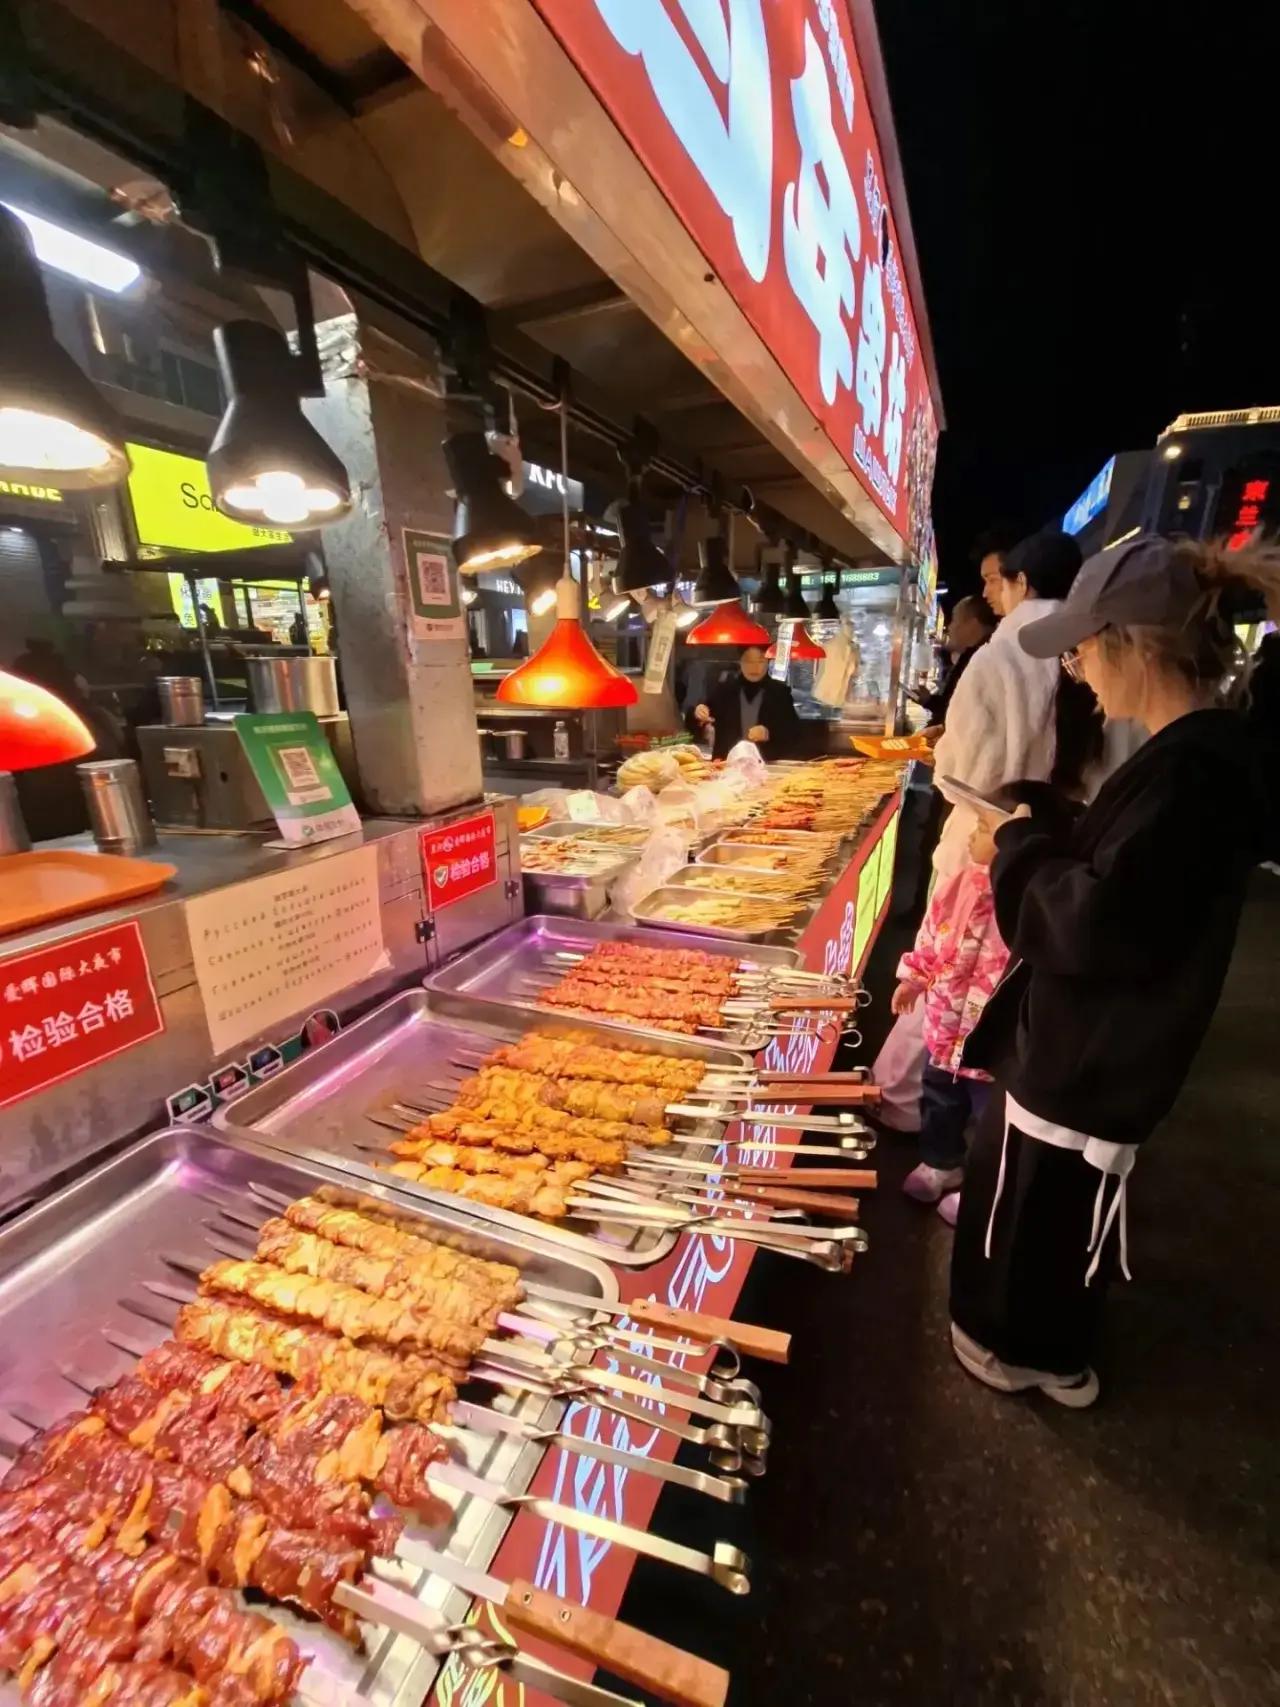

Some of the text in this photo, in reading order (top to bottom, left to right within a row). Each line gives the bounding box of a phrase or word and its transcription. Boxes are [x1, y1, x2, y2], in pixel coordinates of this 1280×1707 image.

[180, 482, 219, 512] Sa
[8, 988, 134, 1062] 检验合格
